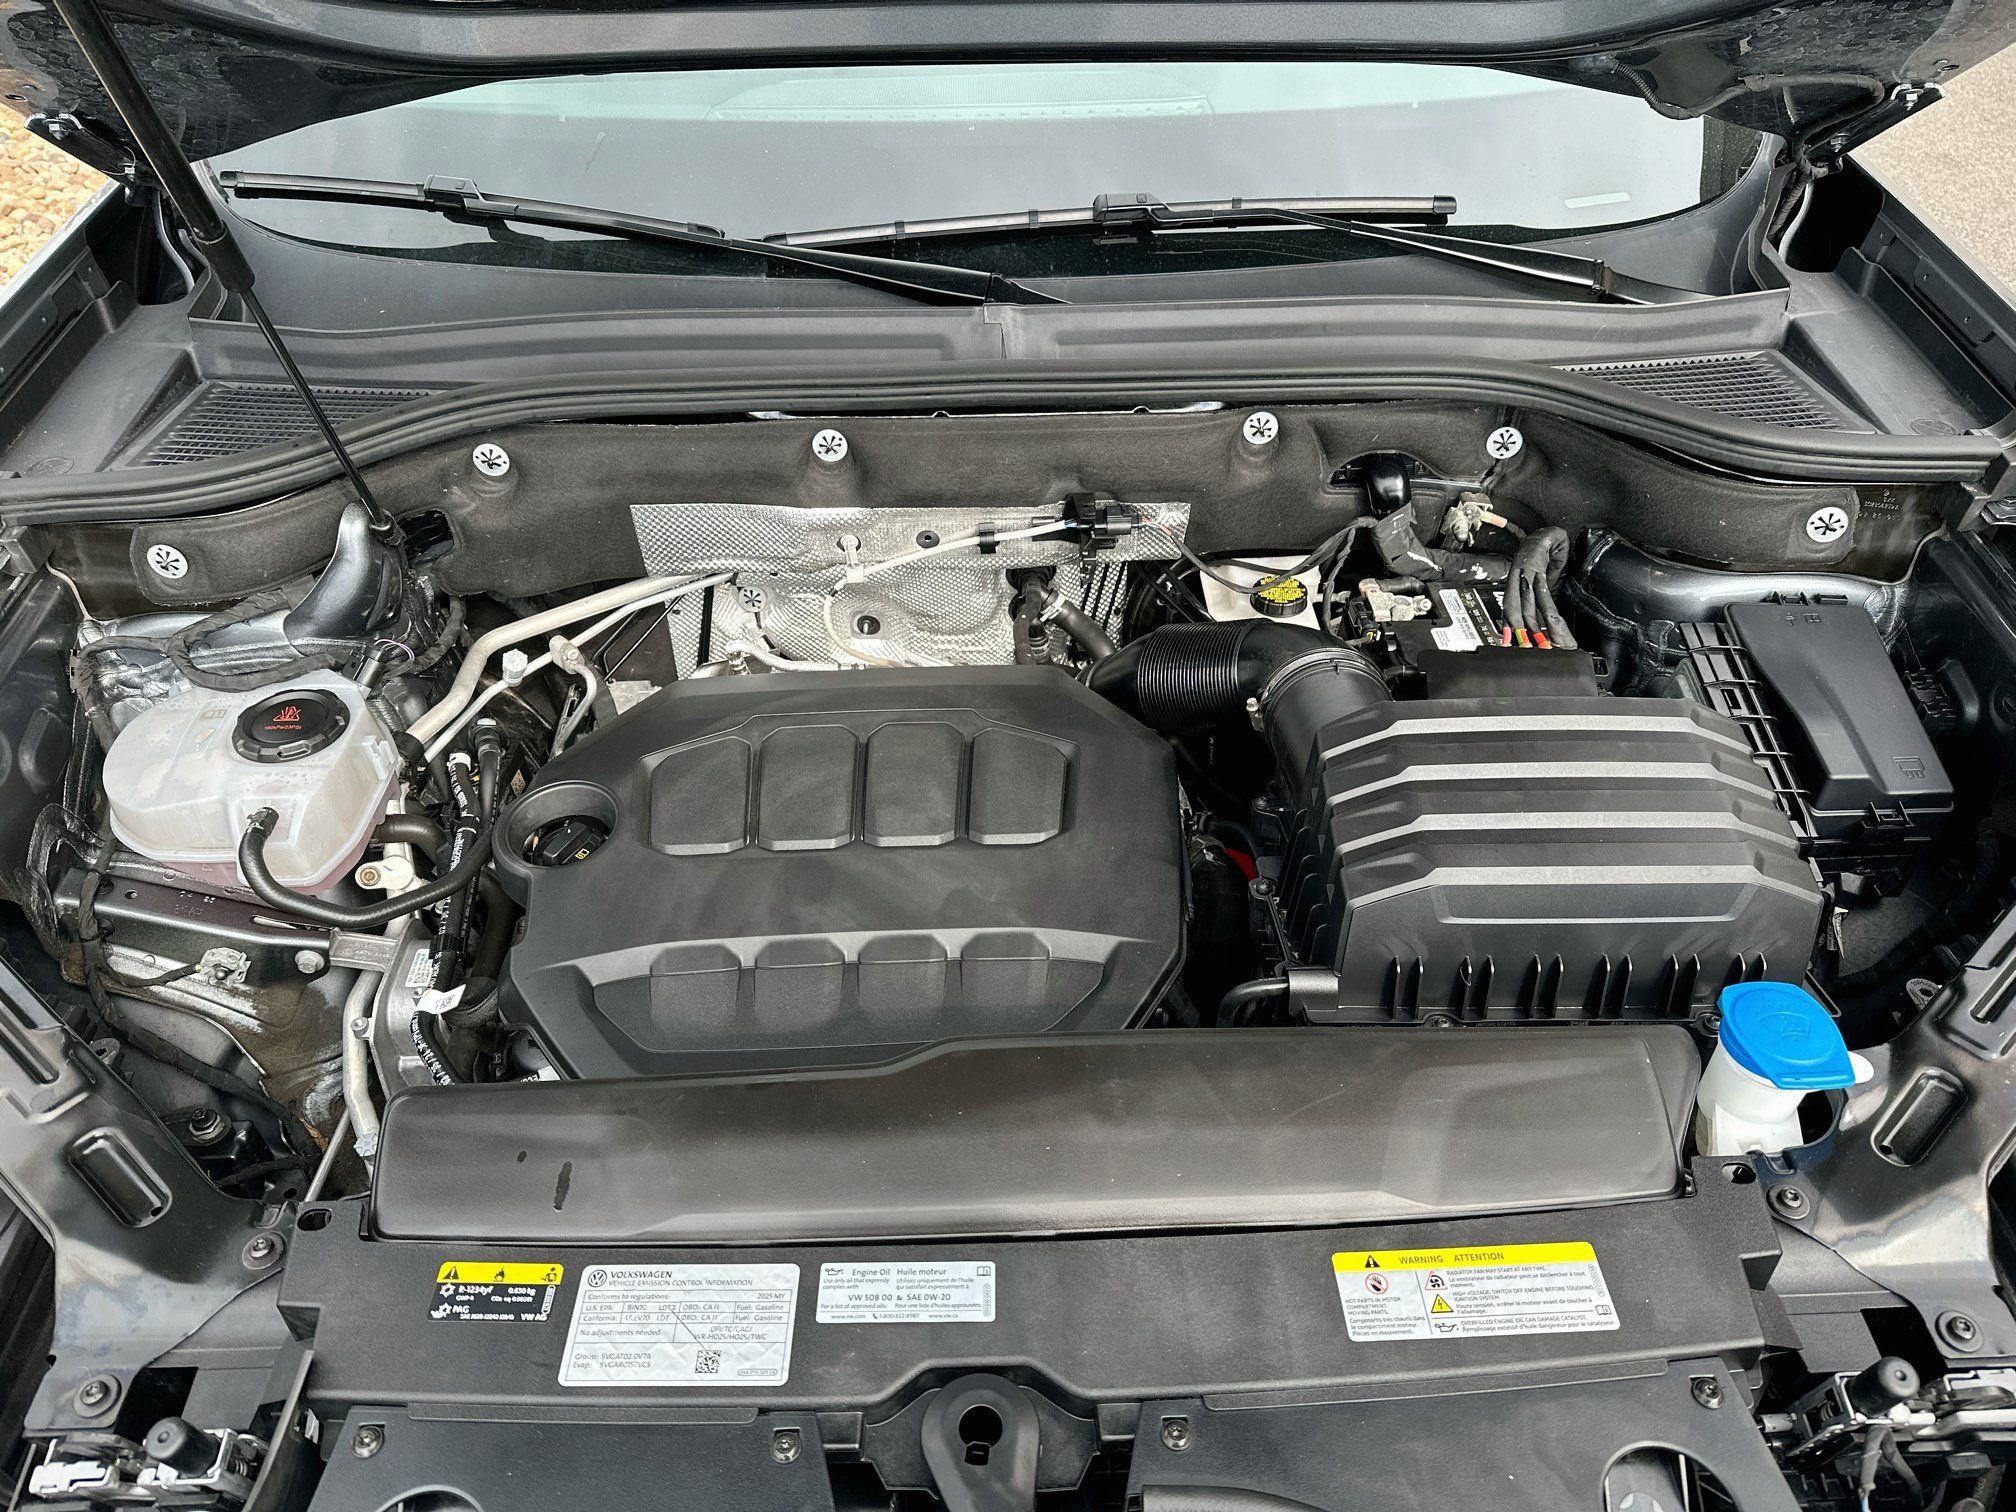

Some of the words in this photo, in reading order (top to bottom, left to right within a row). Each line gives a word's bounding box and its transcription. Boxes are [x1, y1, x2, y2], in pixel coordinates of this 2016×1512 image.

[1399, 1256, 1444, 1264] WARNING
[1454, 1253, 1504, 1262] ATTENTION
[852, 1269, 878, 1277] Engine
[458, 1286, 494, 1295] R-1234yf
